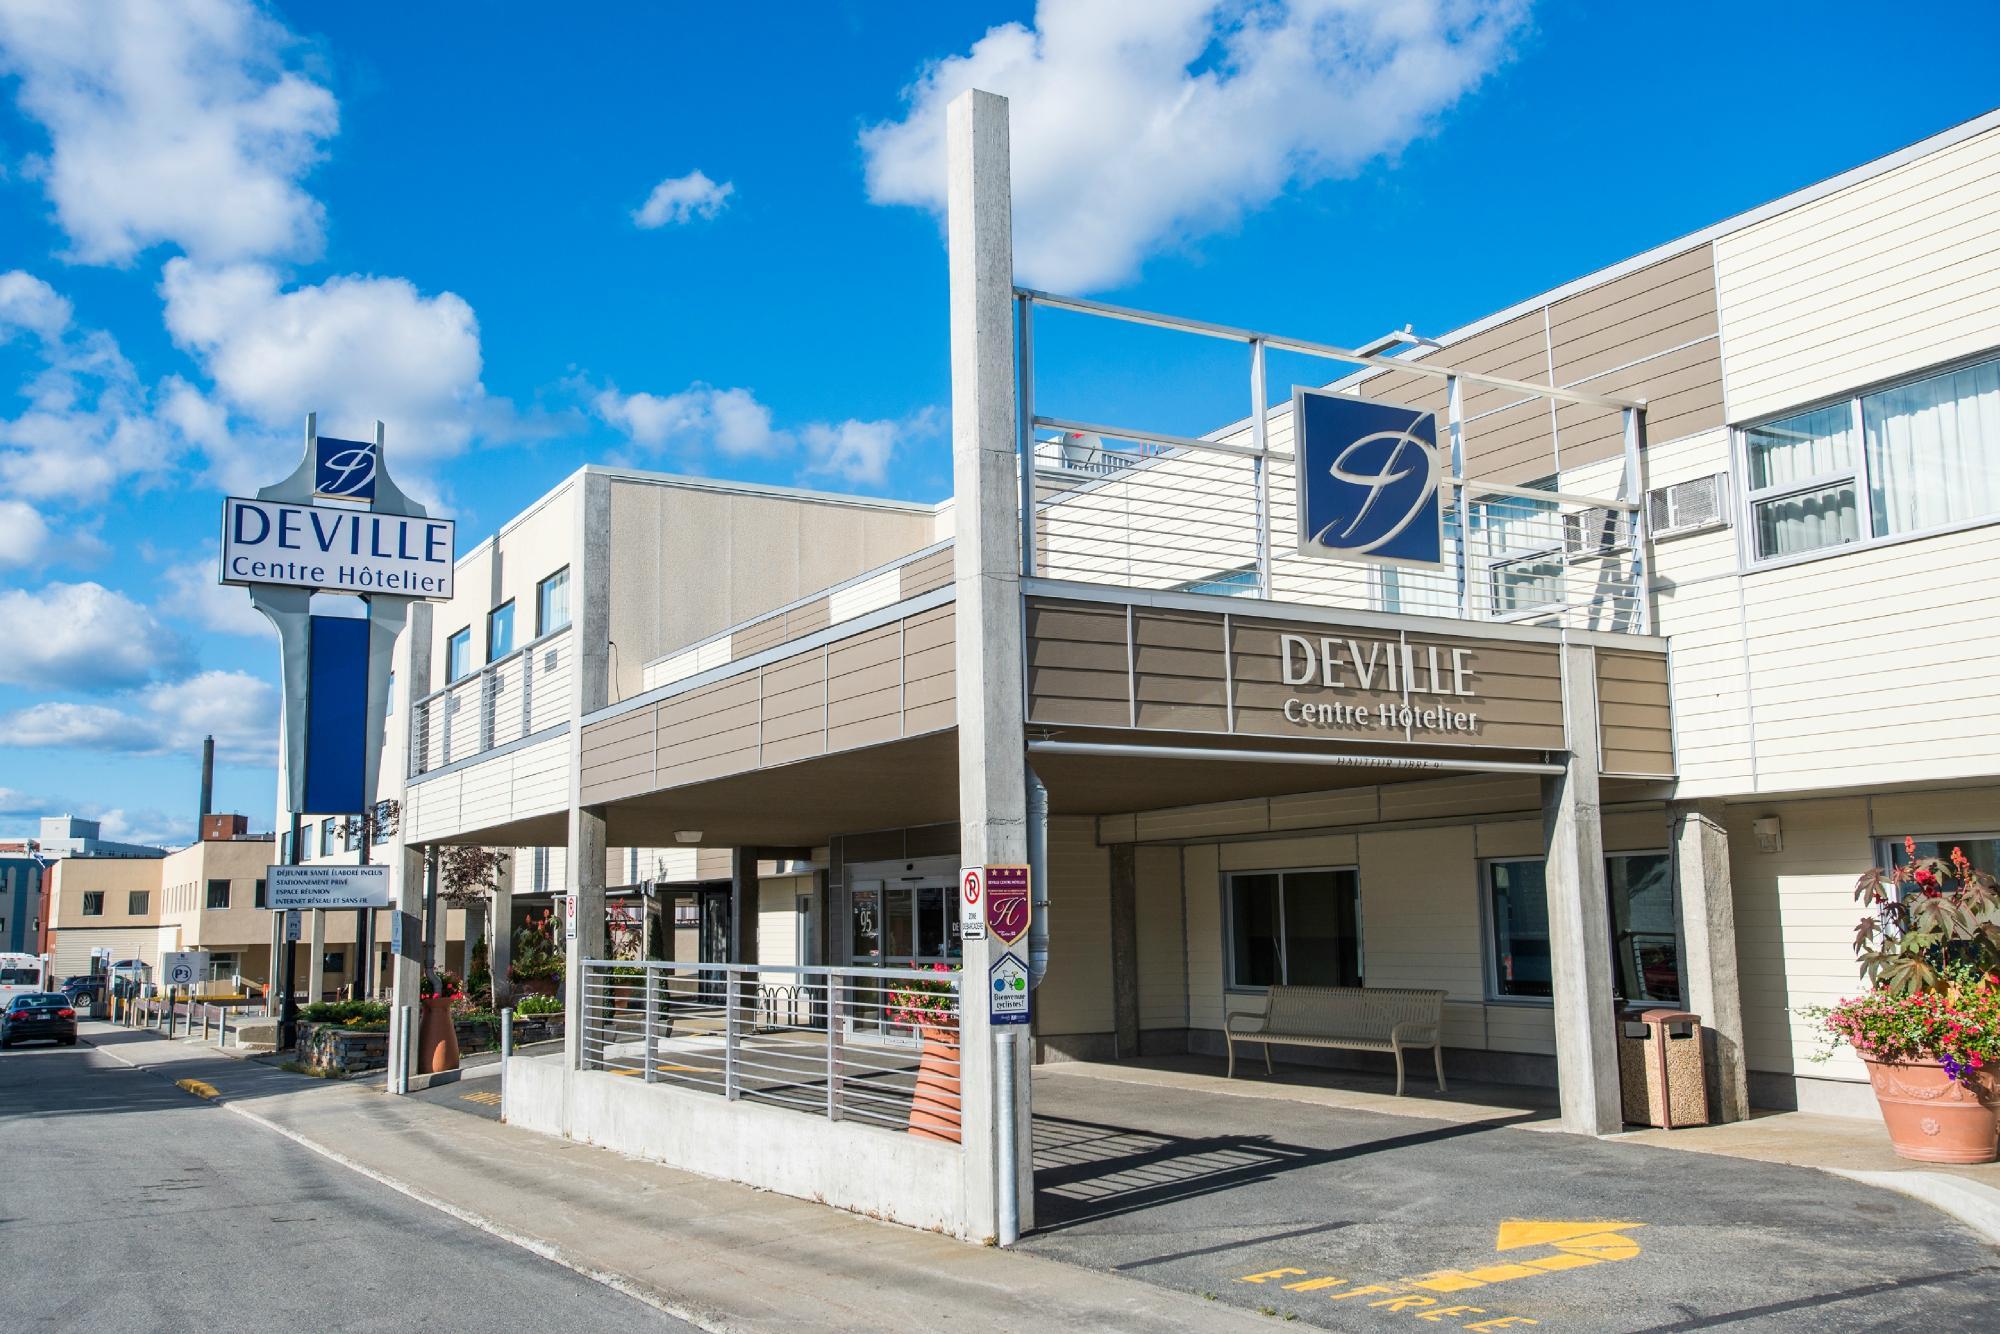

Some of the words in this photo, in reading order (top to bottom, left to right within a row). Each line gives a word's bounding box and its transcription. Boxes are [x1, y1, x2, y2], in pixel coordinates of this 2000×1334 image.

[234, 504, 447, 563] DEVILLE
[232, 556, 325, 582] Centre
[339, 566, 445, 592] Hôtelier
[1281, 634, 1475, 696] DEVILLE
[1284, 698, 1369, 725] Centre
[1379, 704, 1477, 731] Hôtelier
[860, 911, 872, 932] 95
[174, 968, 189, 979] P3
[994, 993, 1026, 1001] Bienvenue
